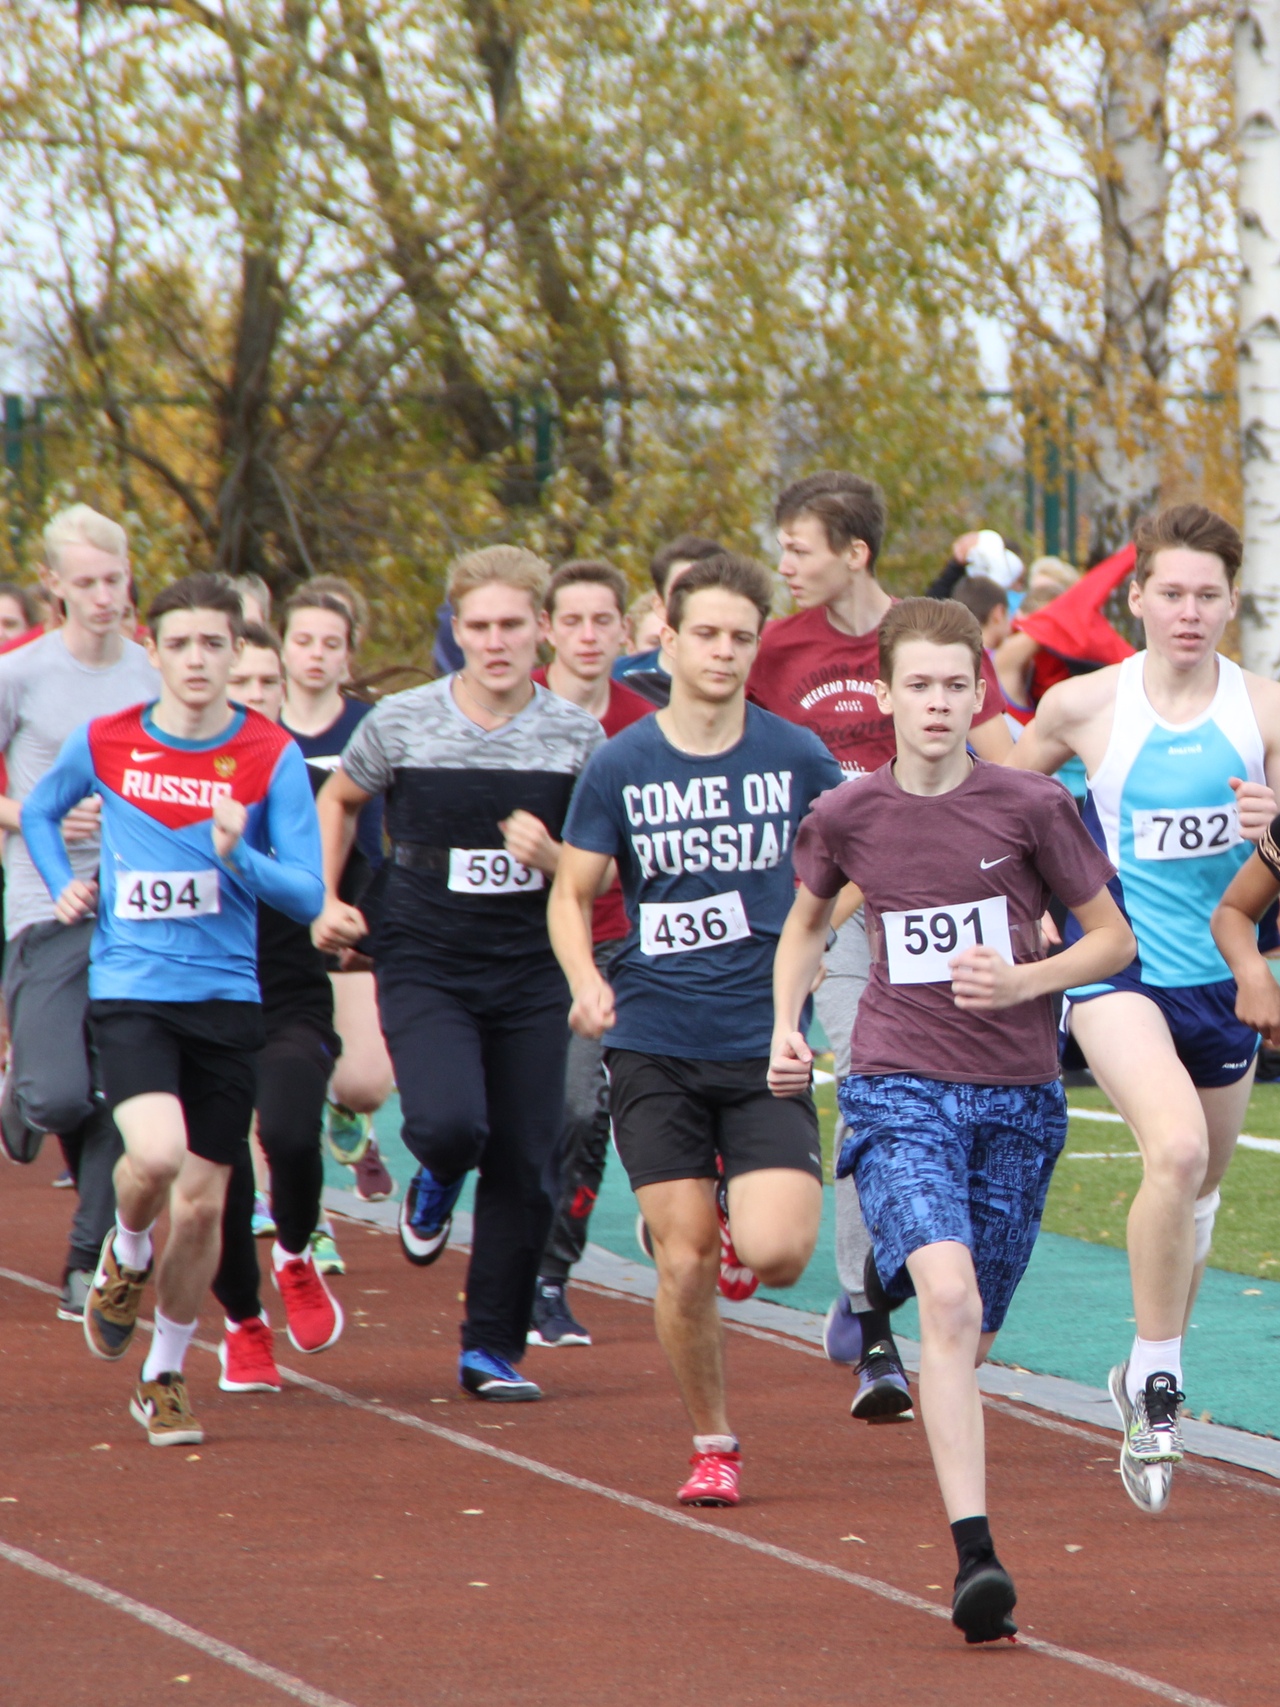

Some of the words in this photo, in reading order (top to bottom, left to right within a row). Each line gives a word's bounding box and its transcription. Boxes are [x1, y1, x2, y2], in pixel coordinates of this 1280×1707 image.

[800, 680, 843, 710] WEEKEND
[622, 776, 730, 827] COME
[743, 770, 792, 815] ON
[1151, 813, 1229, 852] 782
[466, 855, 532, 887] 593
[128, 878, 201, 913] 494
[654, 907, 728, 949] 436
[904, 906, 985, 956] 591
